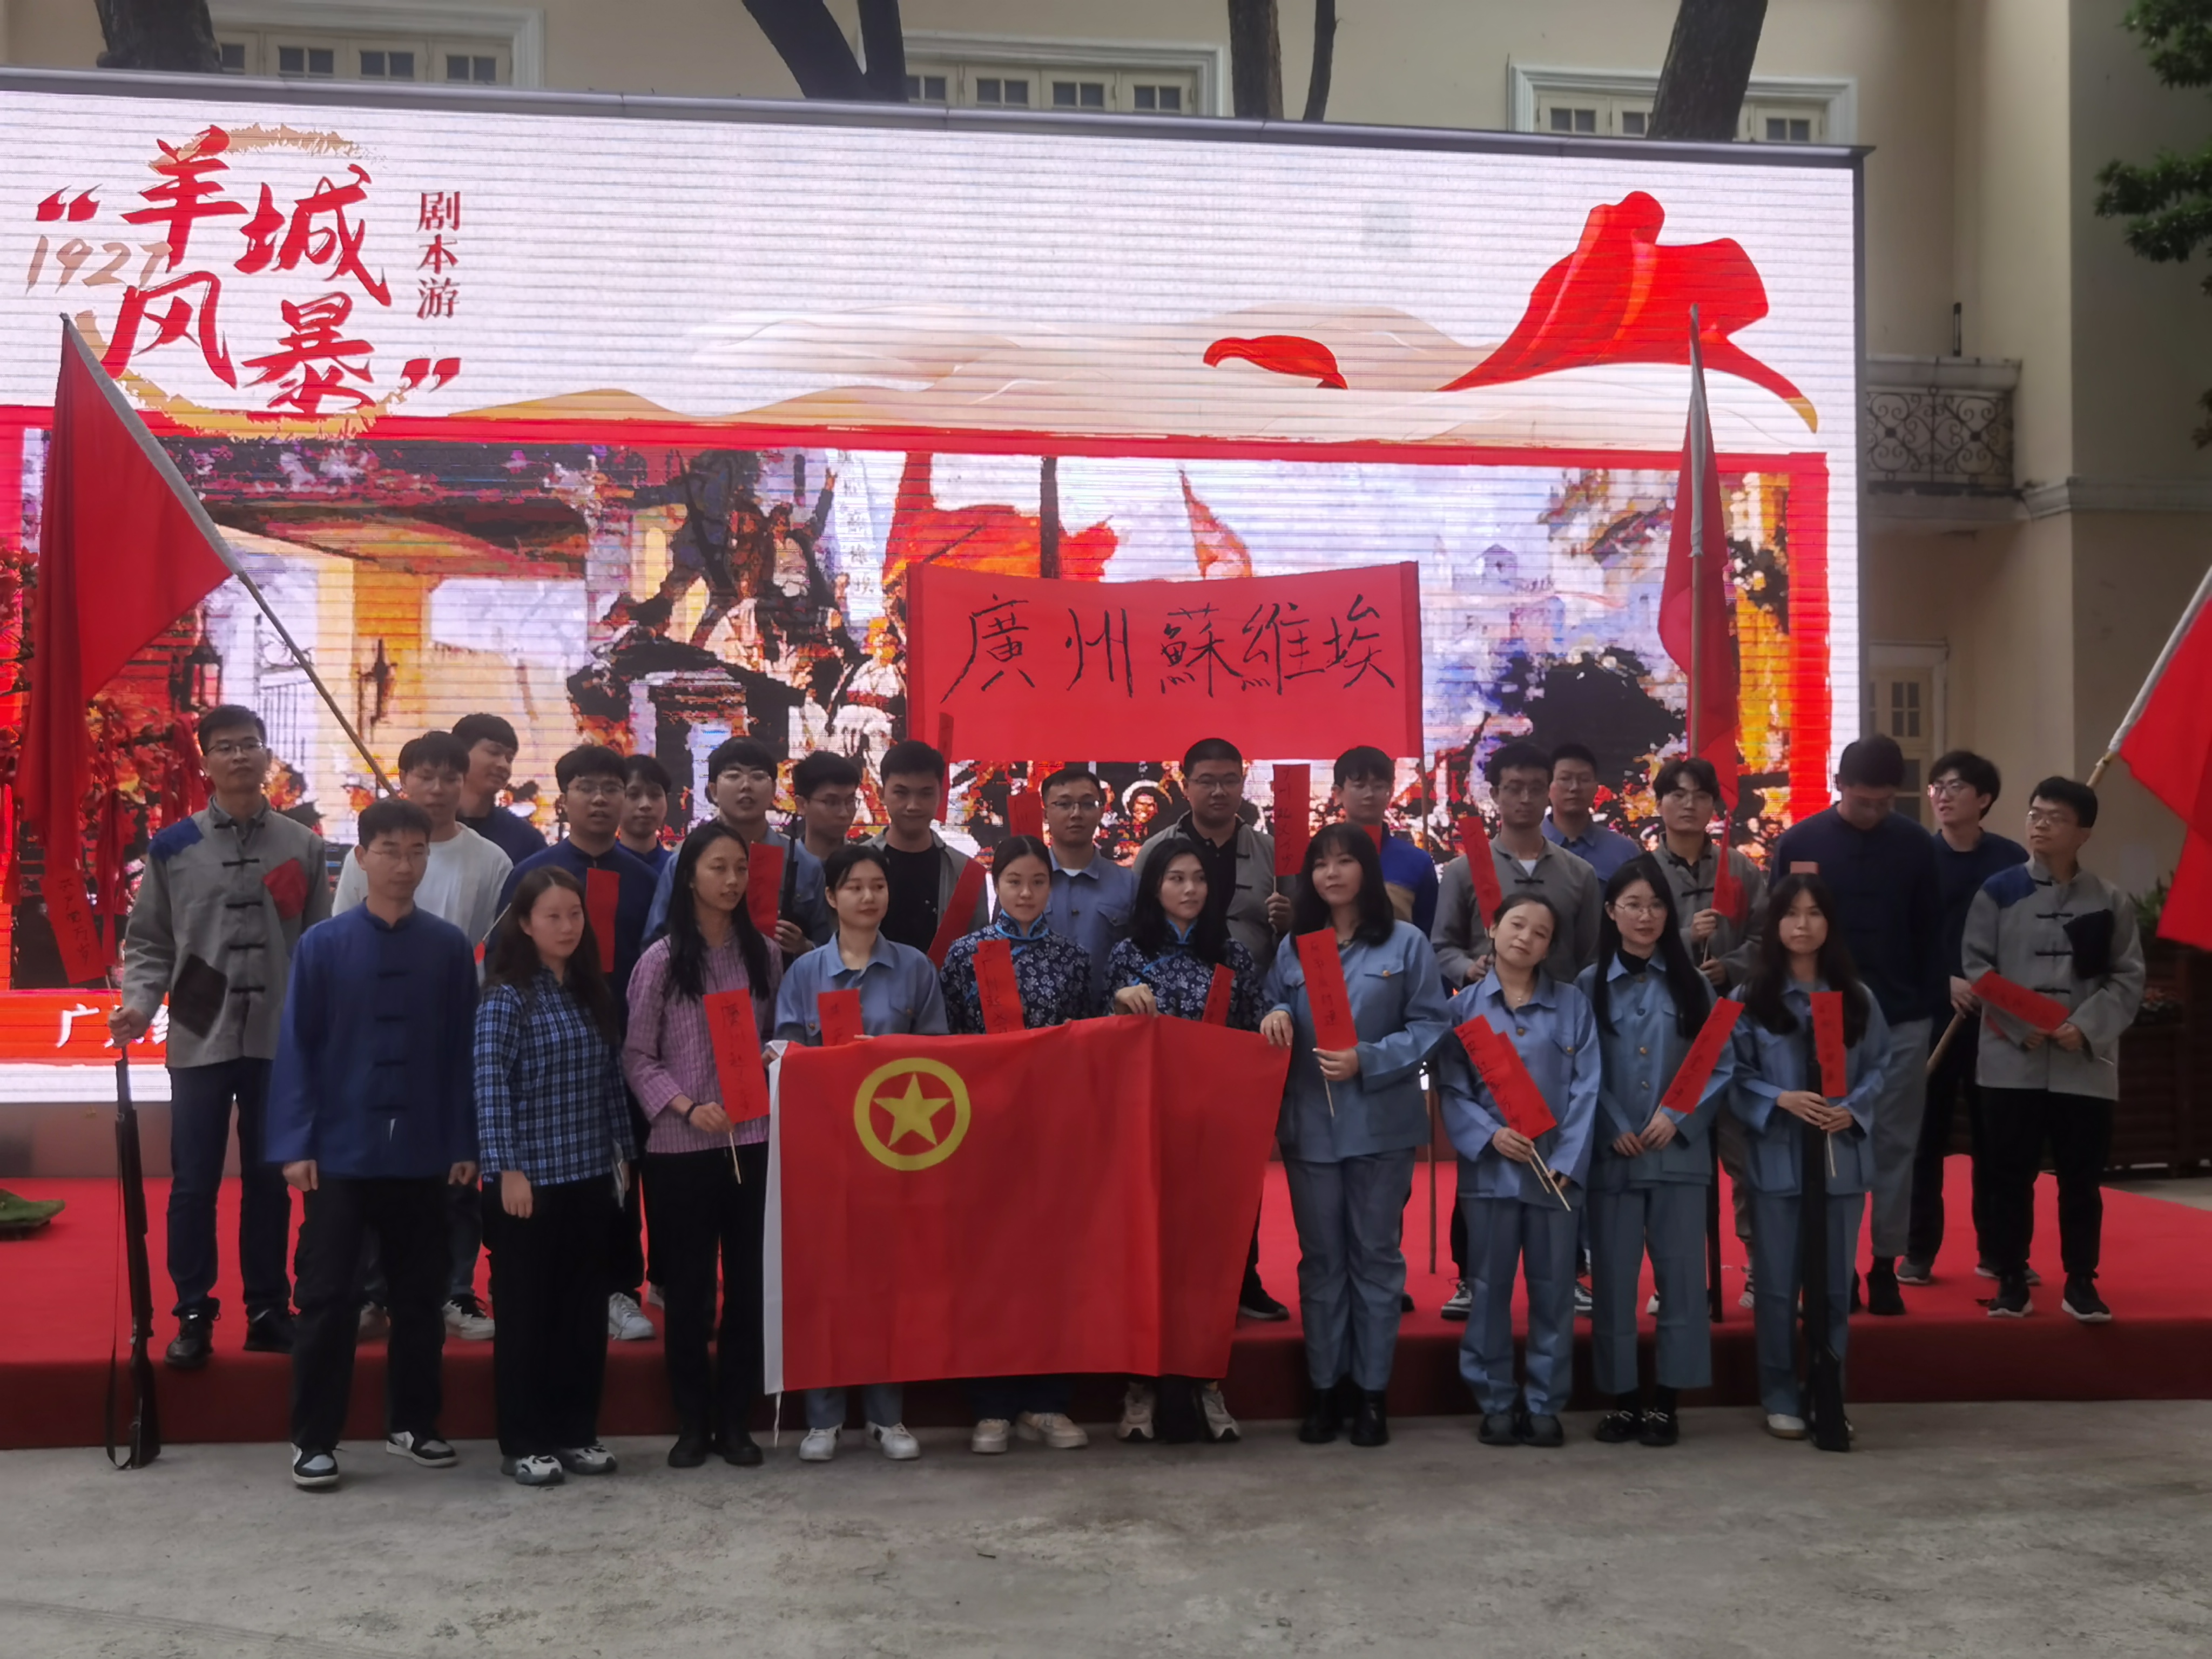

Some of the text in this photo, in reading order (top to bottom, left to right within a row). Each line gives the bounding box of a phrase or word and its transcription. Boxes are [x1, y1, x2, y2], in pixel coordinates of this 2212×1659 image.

[26, 235, 173, 293] 1927
[416, 191, 461, 319] 剧本游
[941, 594, 1394, 703] 廣州蘇維埃
